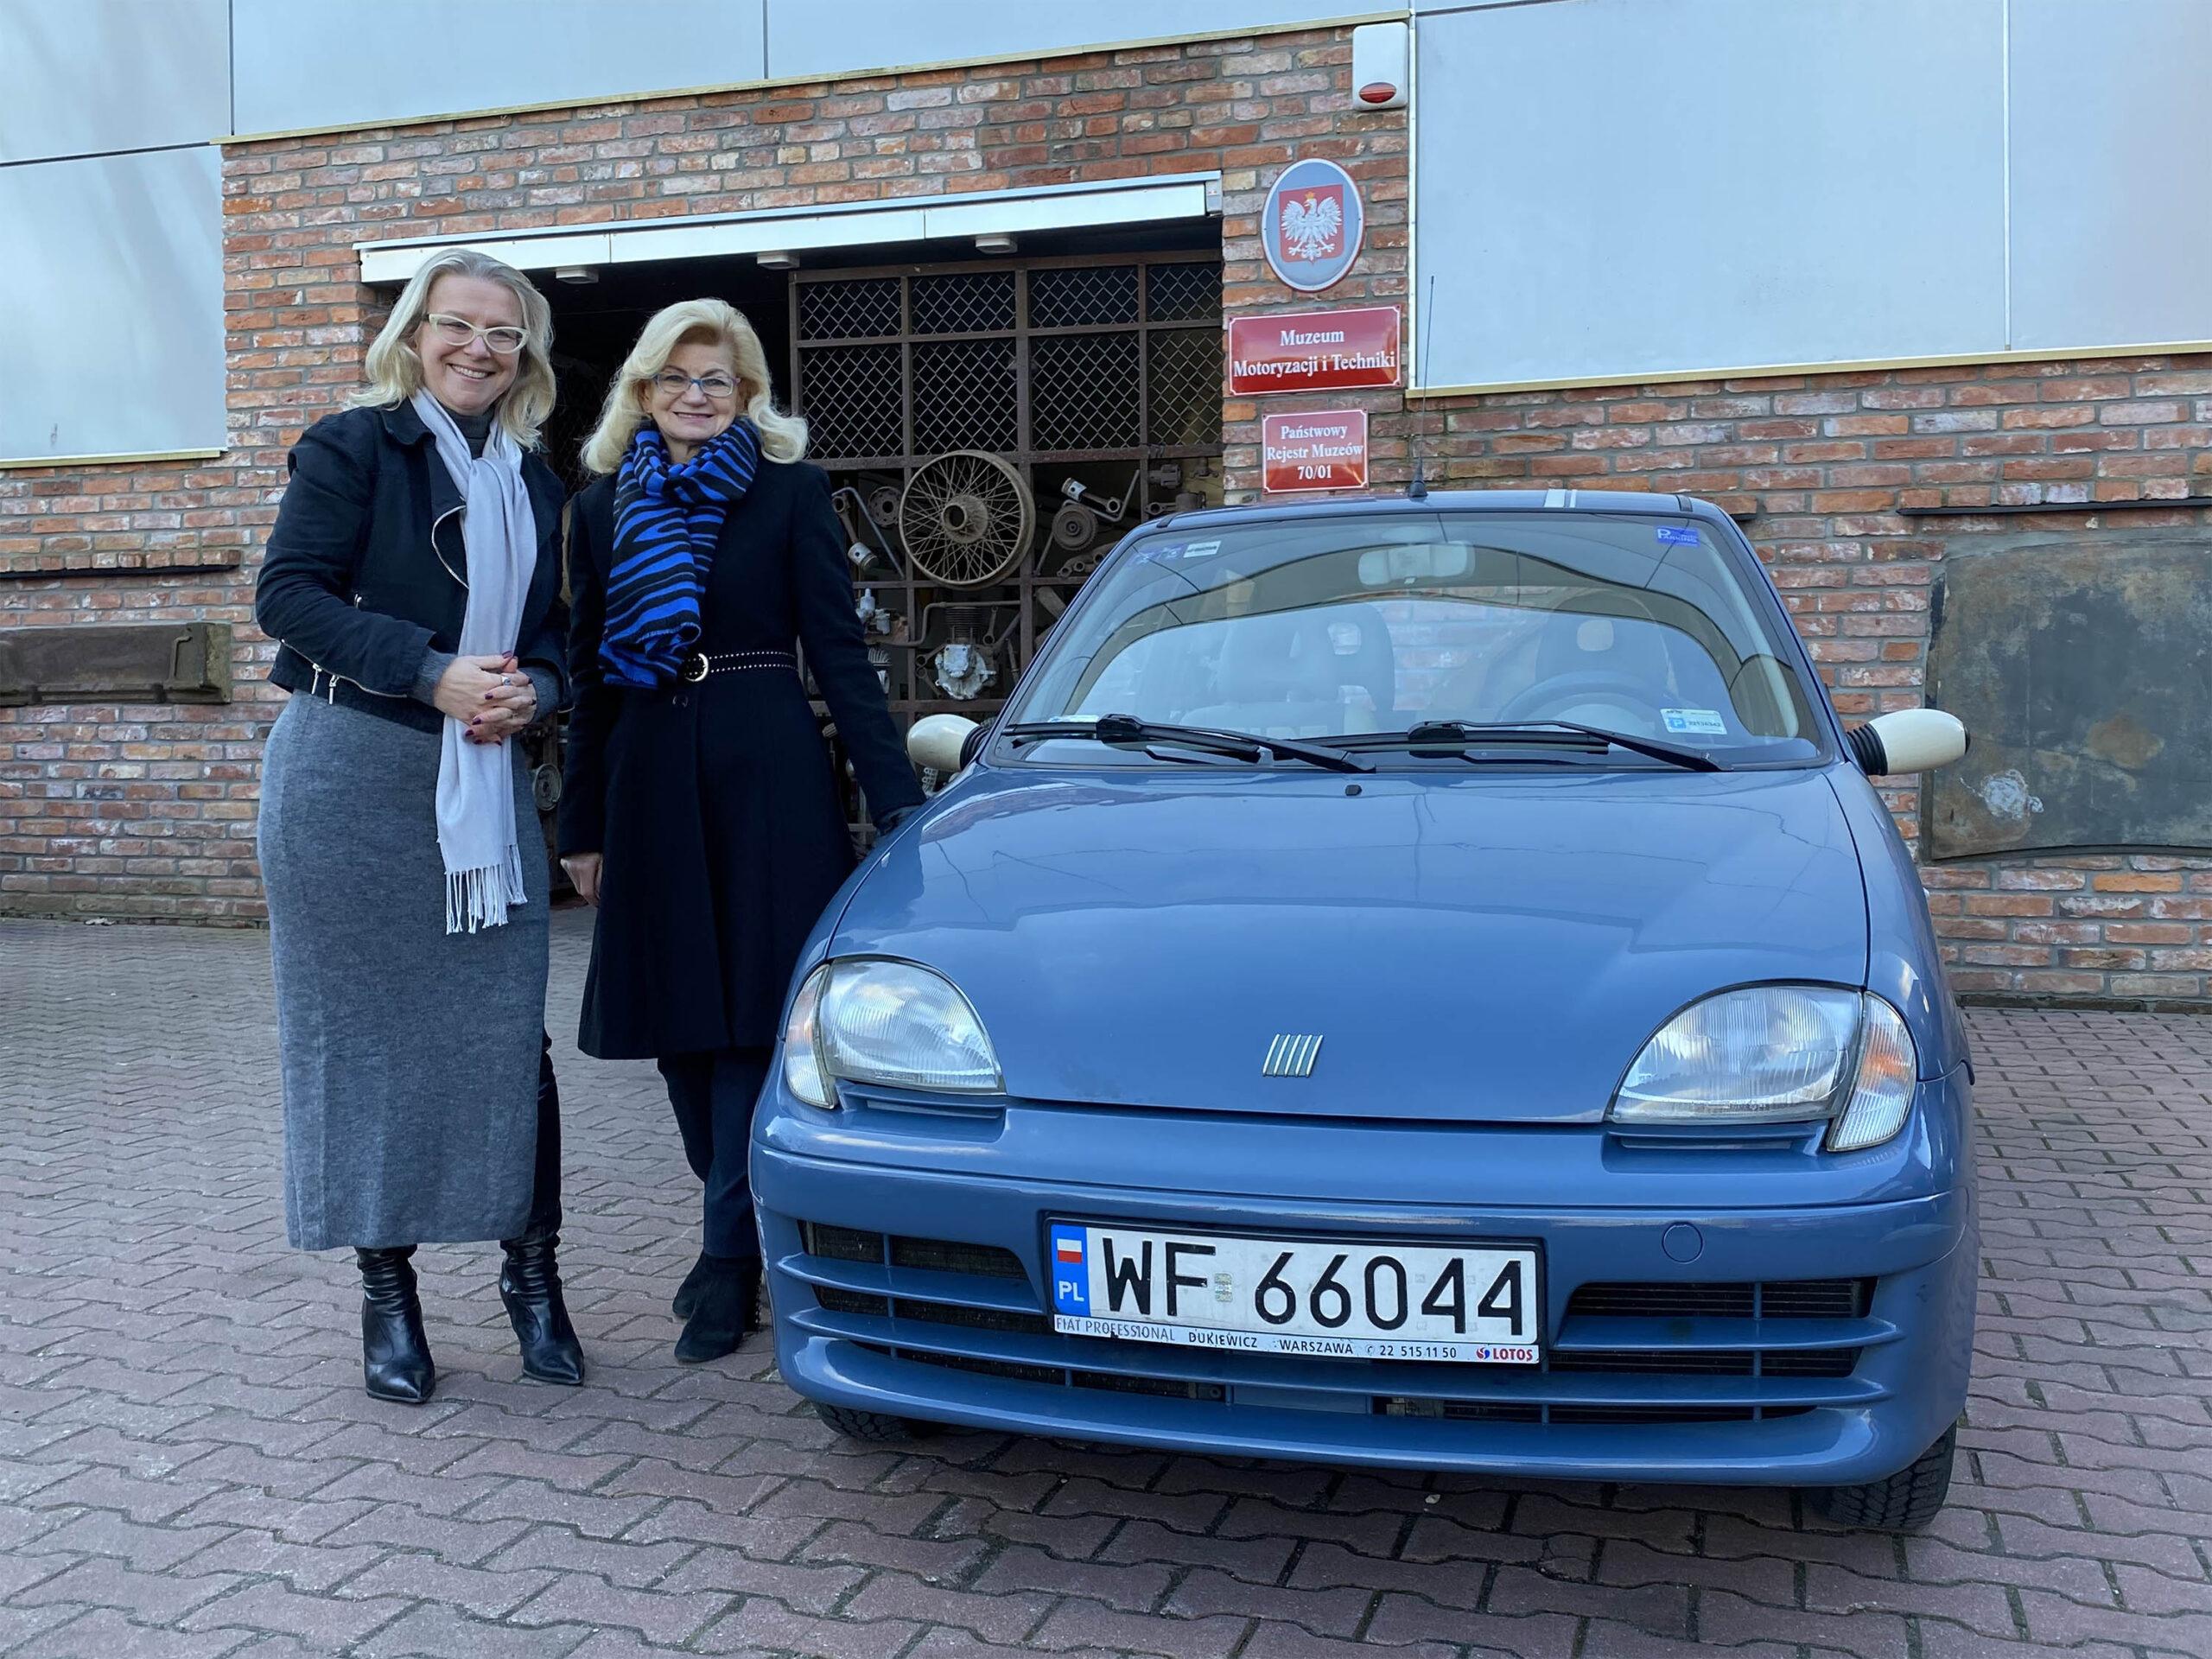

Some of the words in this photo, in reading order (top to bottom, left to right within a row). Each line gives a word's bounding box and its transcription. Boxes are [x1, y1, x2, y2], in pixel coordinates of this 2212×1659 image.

[1280, 330, 1344, 346] Muzeum
[1234, 357, 1319, 378] Motoryzacji
[1322, 355, 1328, 372] i
[1331, 351, 1395, 369] Techniki
[1281, 424, 1348, 440] Państwowy
[1267, 444, 1309, 462] Rejestr
[1312, 442, 1363, 457] Muzeów
[1297, 465, 1332, 480] 70/01
[1058, 1281, 1084, 1302] PL
[1103, 1237, 1216, 1316] WF
[1254, 1251, 1523, 1337] 66044
[1056, 1316, 1082, 1332] FIAT
[1085, 1319, 1175, 1341] PROFESSIONAL
[1188, 1332, 1258, 1349] DUKIEWICZ
[1279, 1338, 1354, 1357] WARSZAWA
[1380, 1344, 1395, 1357] 22
[1401, 1345, 1423, 1359] 515
[1426, 1346, 1440, 1359] 11
[1441, 1346, 1458, 1360] 50
[1493, 1348, 1535, 1363] LOTOS
